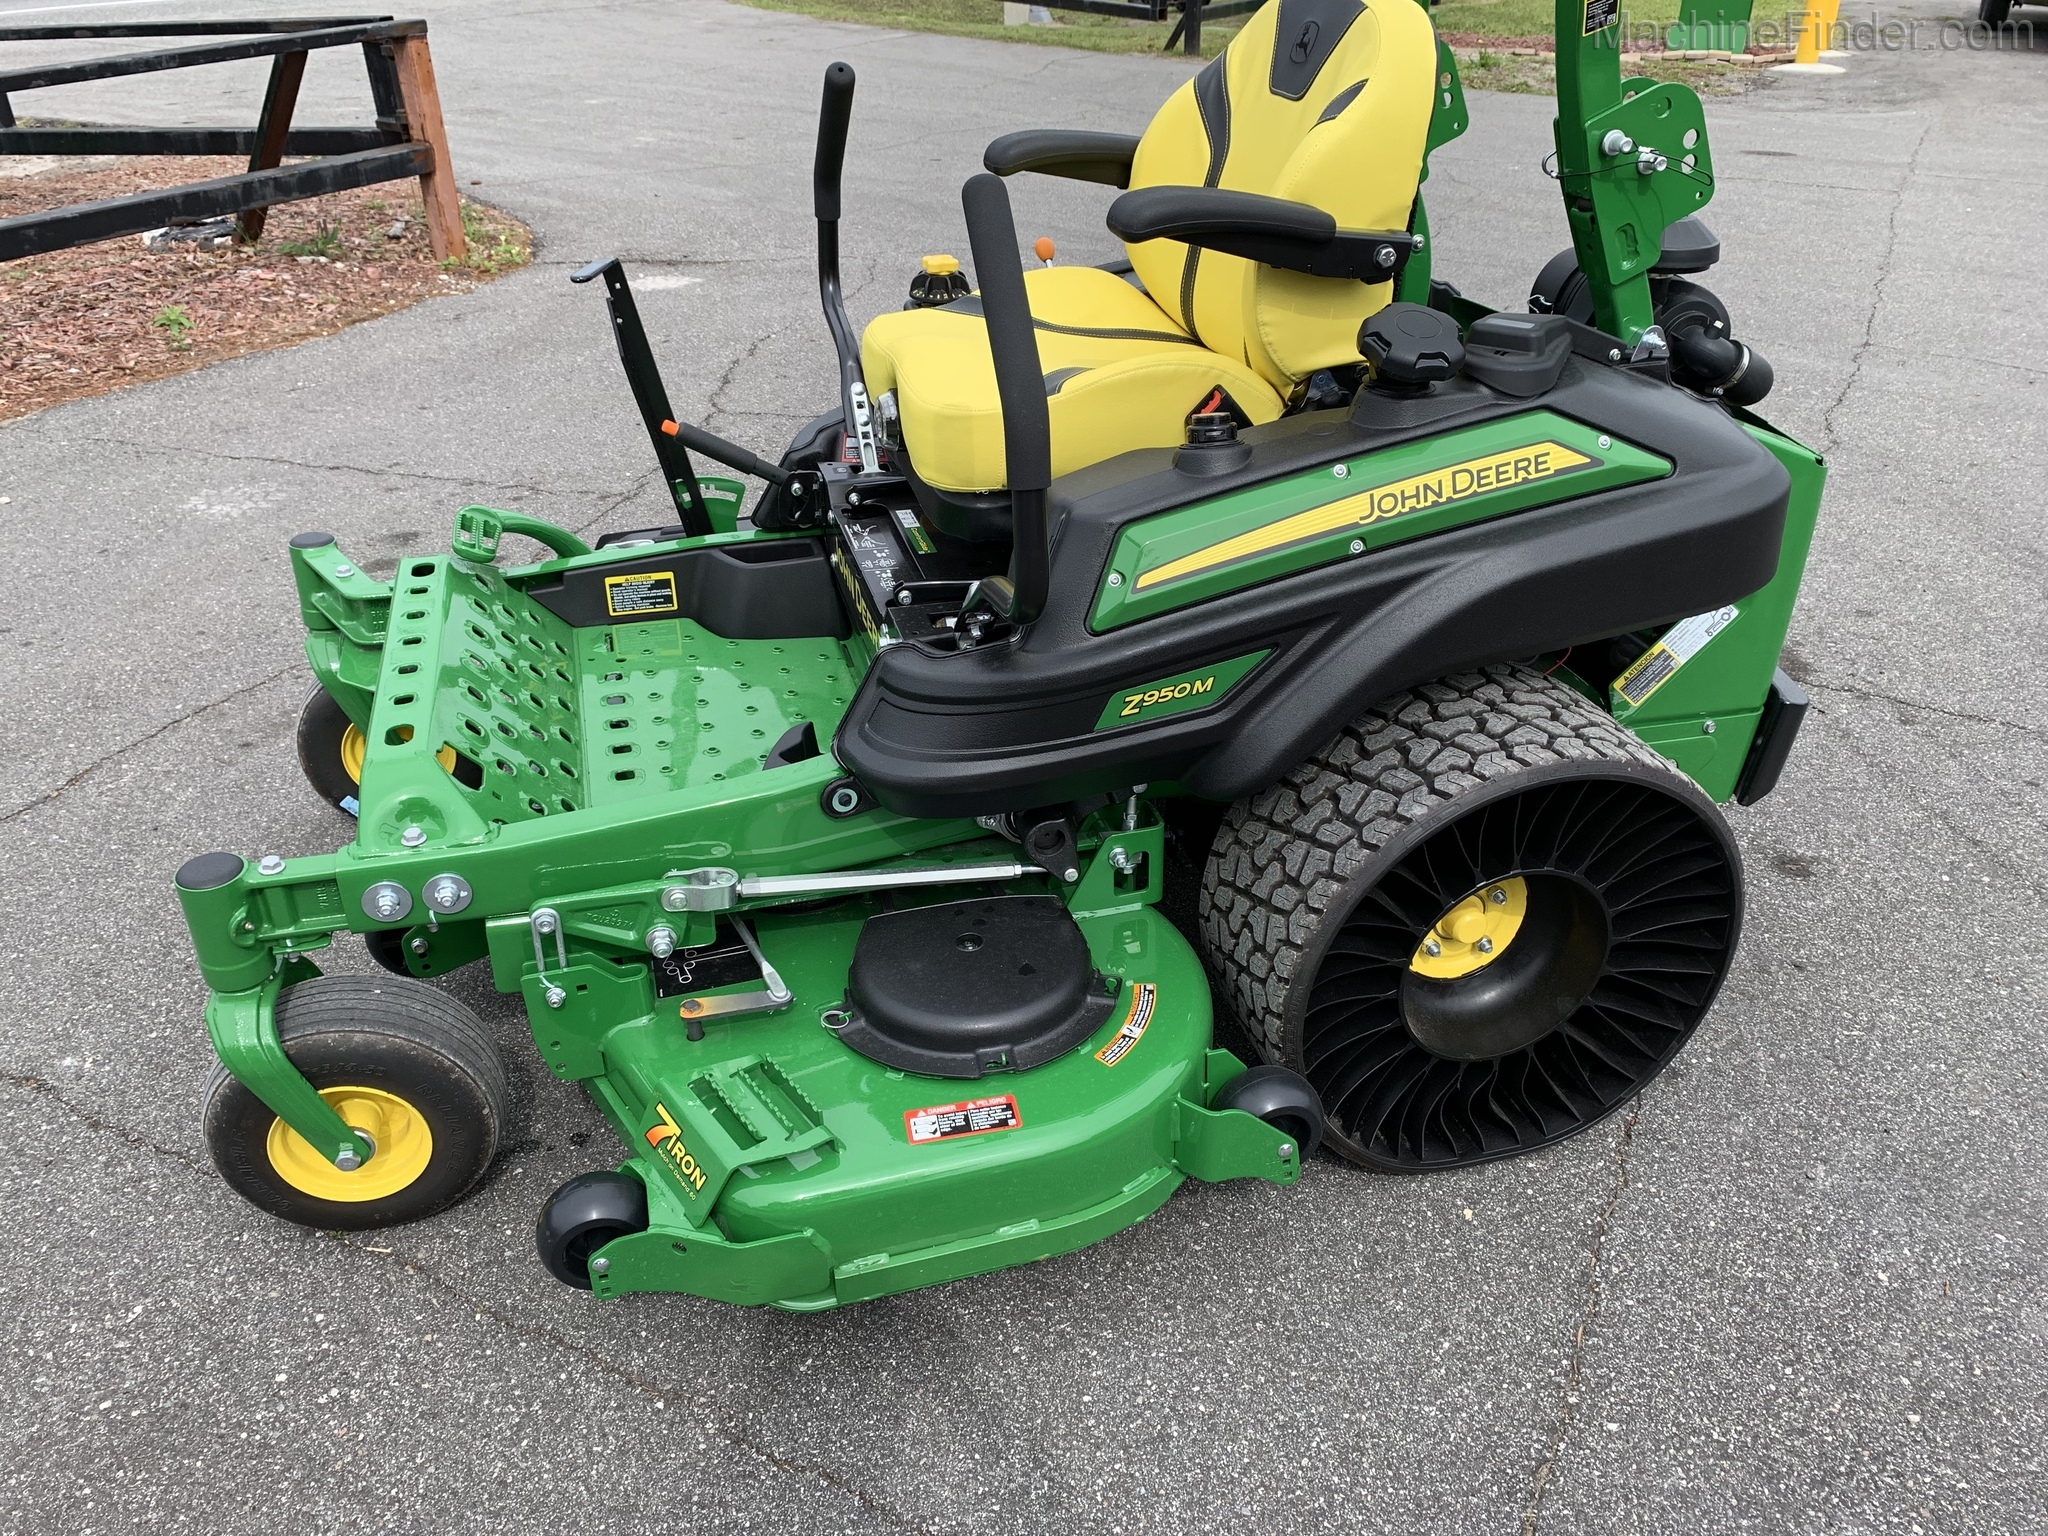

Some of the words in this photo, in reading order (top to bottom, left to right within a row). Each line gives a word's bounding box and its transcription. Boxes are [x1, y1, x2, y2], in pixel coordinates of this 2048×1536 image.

[1359, 479, 1444, 522] JOHN
[1452, 452, 1551, 496] DEERE
[1120, 676, 1215, 717] Z950M
[928, 1105, 957, 1115] DANGER
[976, 1097, 1007, 1107] PELIGRO
[415, 1083, 467, 1174] RELIANCE
[658, 1147, 669, 1164] Mulch
[673, 1169, 690, 1193] Demand
